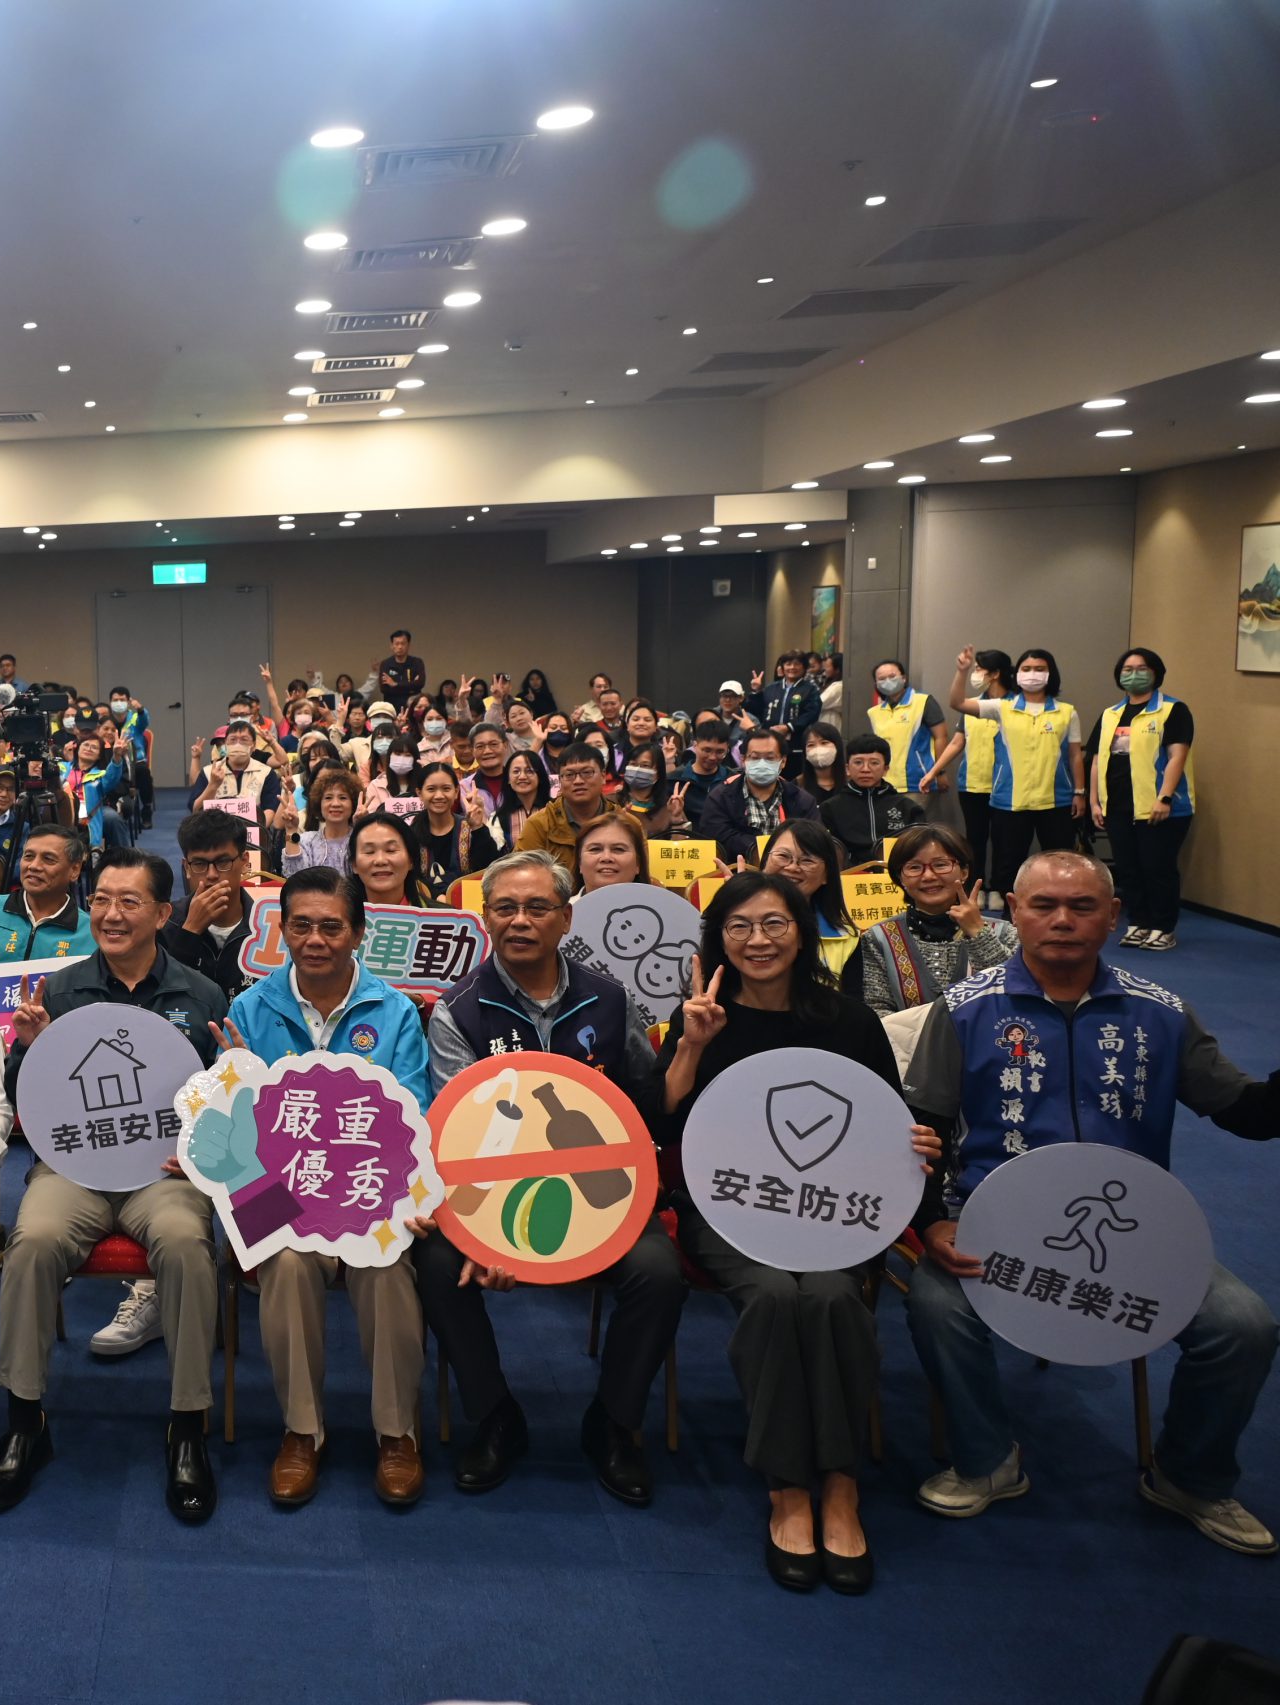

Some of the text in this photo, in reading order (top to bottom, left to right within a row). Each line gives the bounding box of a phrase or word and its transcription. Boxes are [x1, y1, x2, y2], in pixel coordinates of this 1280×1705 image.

[660, 847, 700, 860] 國計處
[855, 882, 899, 897] 貴賓或
[365, 922, 476, 982] 運動
[1096, 1022, 1126, 1120] 高美珠
[271, 1087, 381, 1150] 嚴重
[280, 1148, 389, 1211] 優秀
[710, 1167, 884, 1233] 安全防災
[981, 1249, 1161, 1335] 健康樂活
